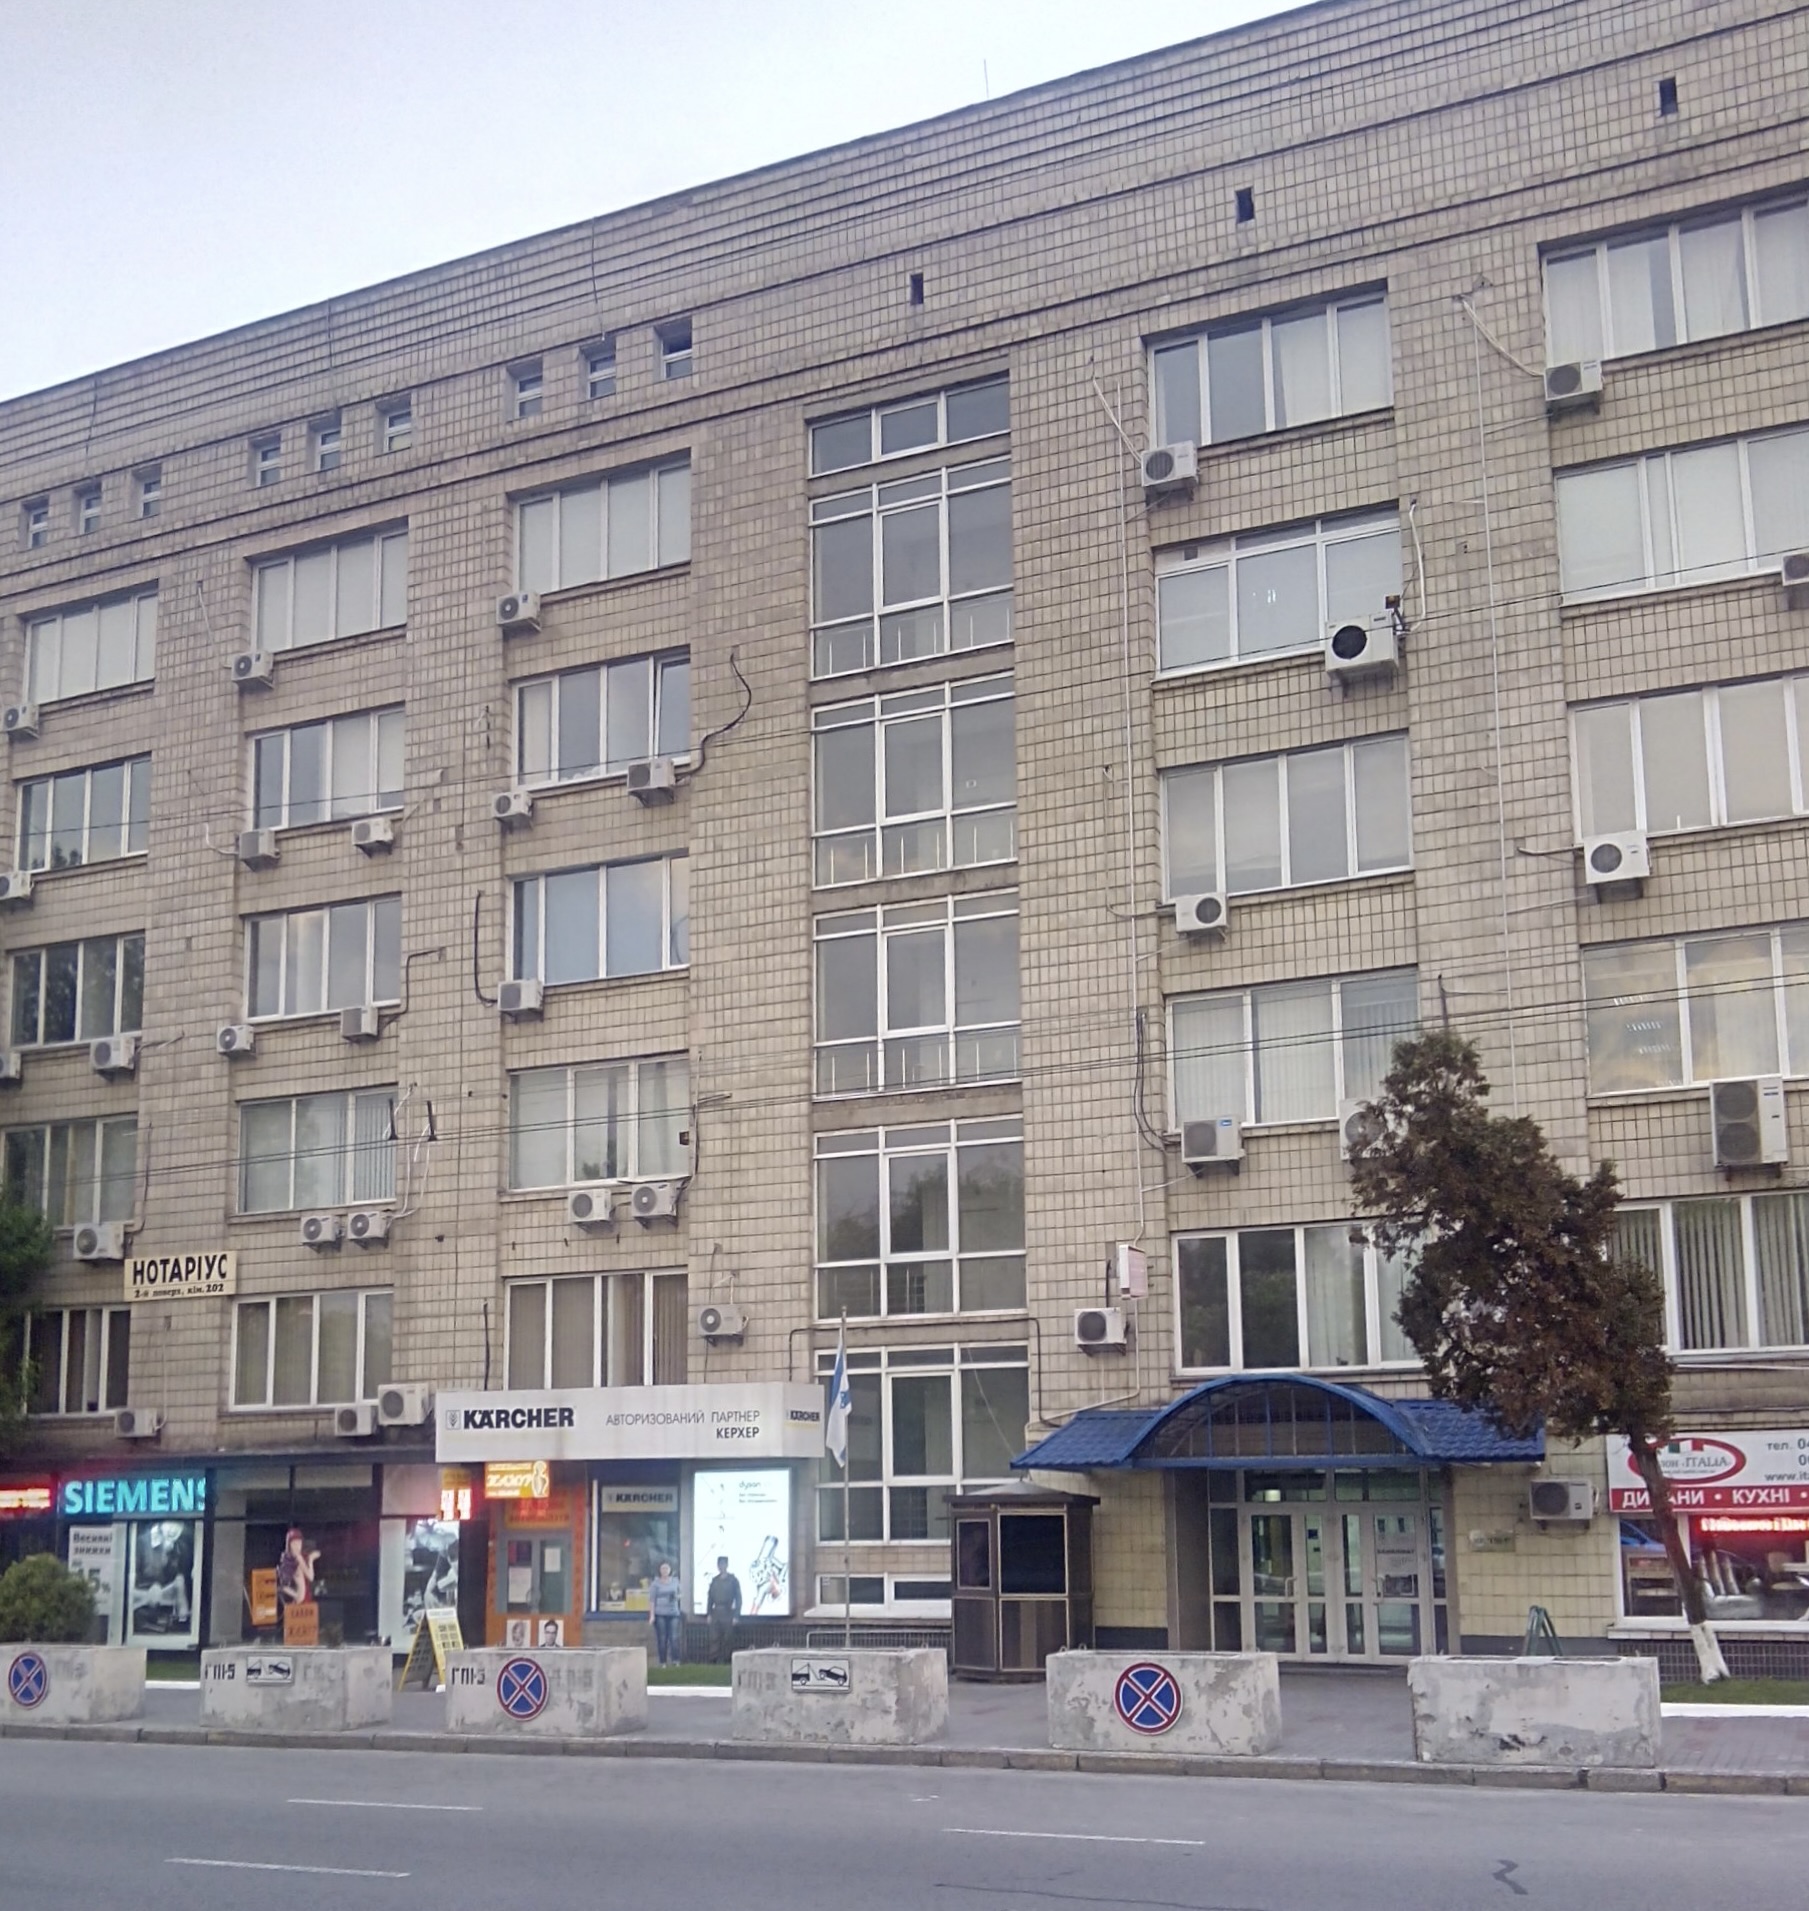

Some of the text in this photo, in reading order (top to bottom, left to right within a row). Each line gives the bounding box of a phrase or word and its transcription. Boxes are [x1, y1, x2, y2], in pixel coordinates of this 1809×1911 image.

[133, 1254, 228, 1285] НОТАРІУС
[206, 1283, 224, 1293] 202
[463, 1407, 575, 1429] KÄRCHER
[606, 1410, 760, 1425] АВТОРИЗОВАНИЙ ПАРТНЕР
[716, 1427, 760, 1439] КЕРХЕР
[1797, 1437, 1809, 1450] 0
[1798, 1454, 1809, 1466] 0
[1622, 1488, 1790, 1508] ДИНИ КУХНІ
